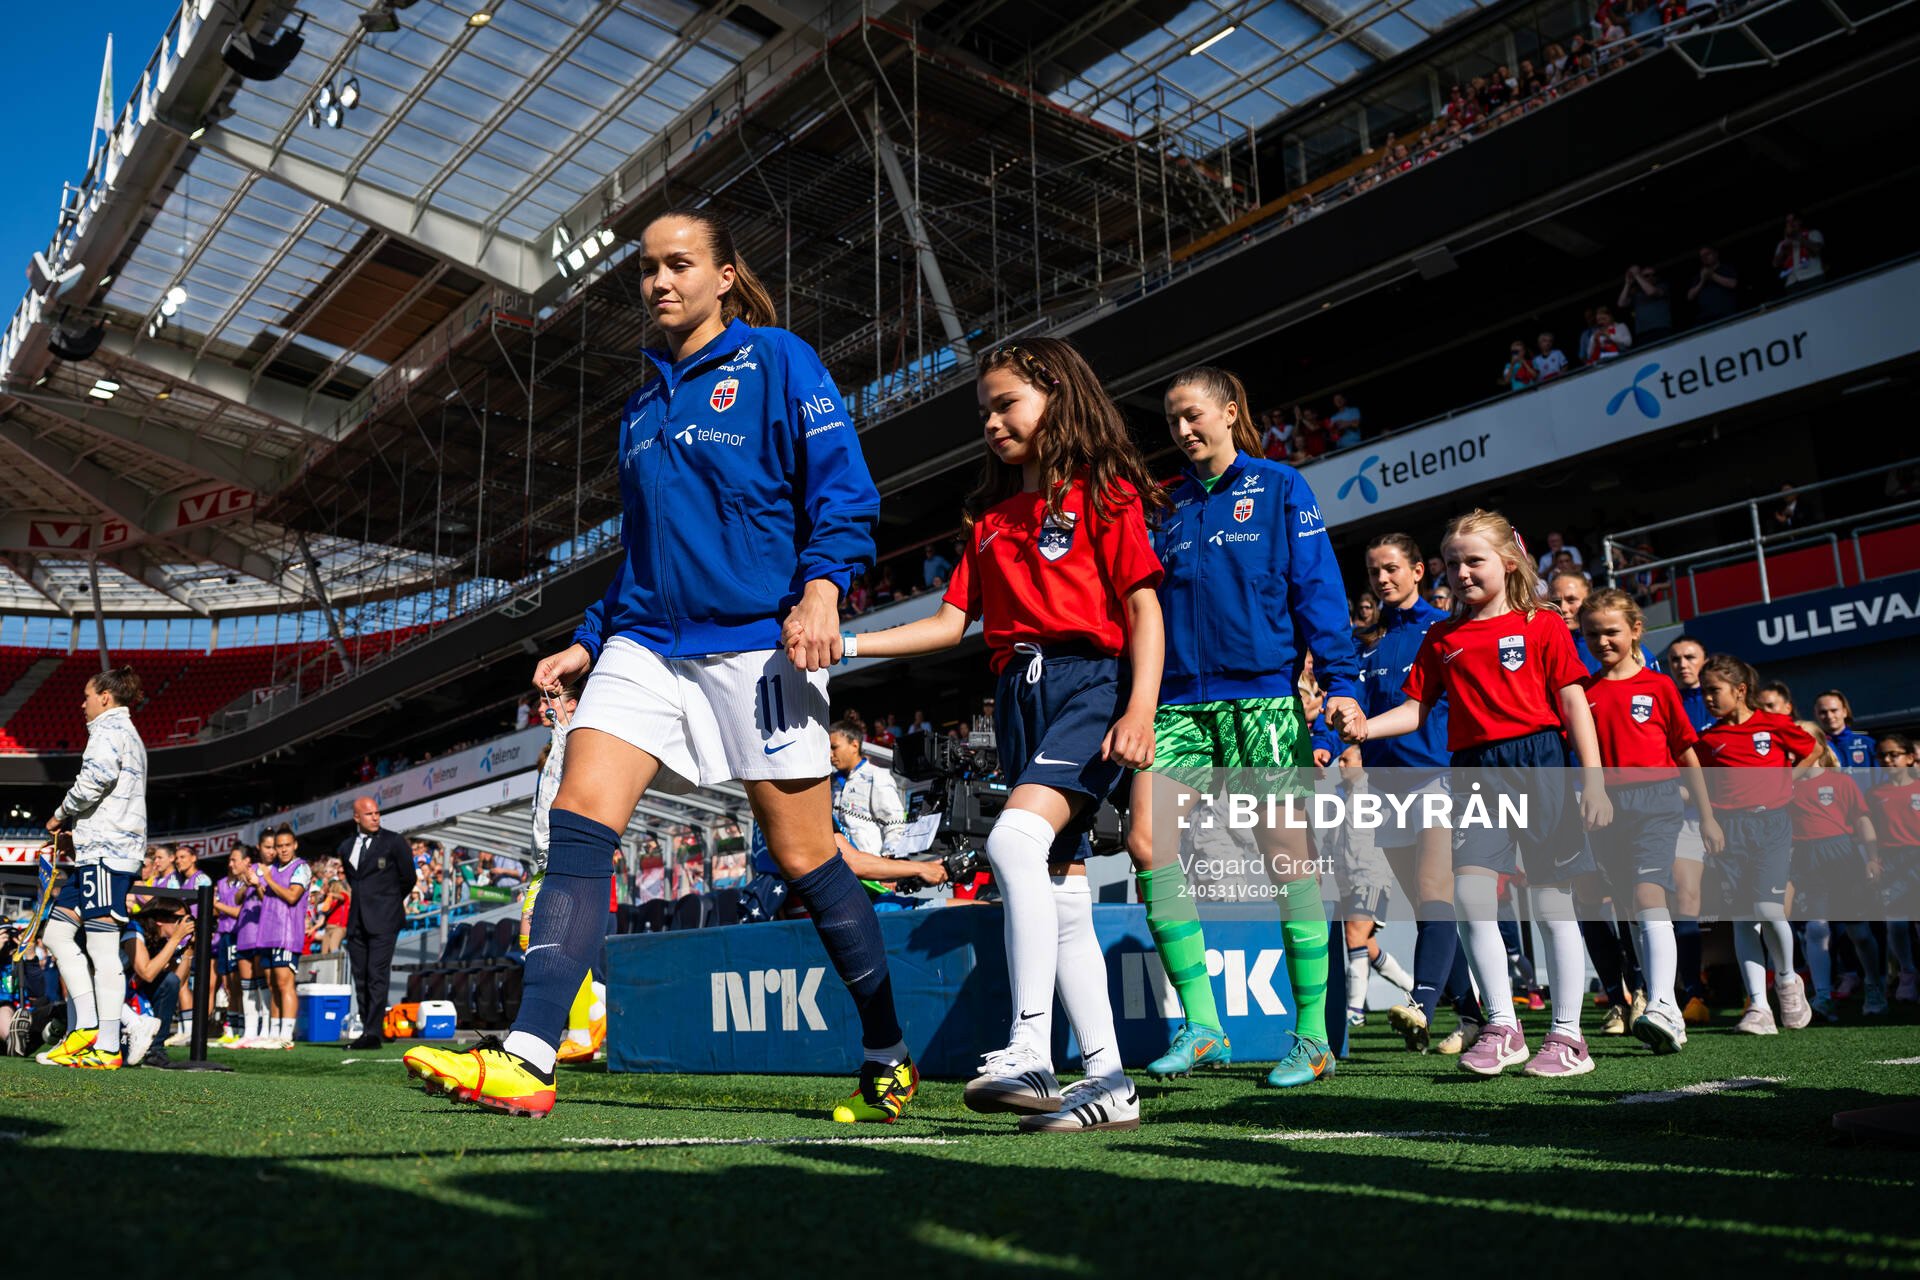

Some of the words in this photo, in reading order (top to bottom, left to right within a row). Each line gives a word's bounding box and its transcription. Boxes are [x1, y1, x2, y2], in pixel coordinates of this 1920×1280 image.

[1660, 331, 1807, 399] telenor
[697, 427, 746, 446] telenor
[1379, 433, 1490, 487] telenor
[182, 487, 253, 522] VG
[1225, 532, 1260, 542] telenor
[1757, 593, 1920, 645] ULLEVA
[757, 674, 786, 734] 11
[1268, 723, 1281, 767] 1
[82, 870, 96, 898] 5
[1121, 949, 1287, 1019] NK
